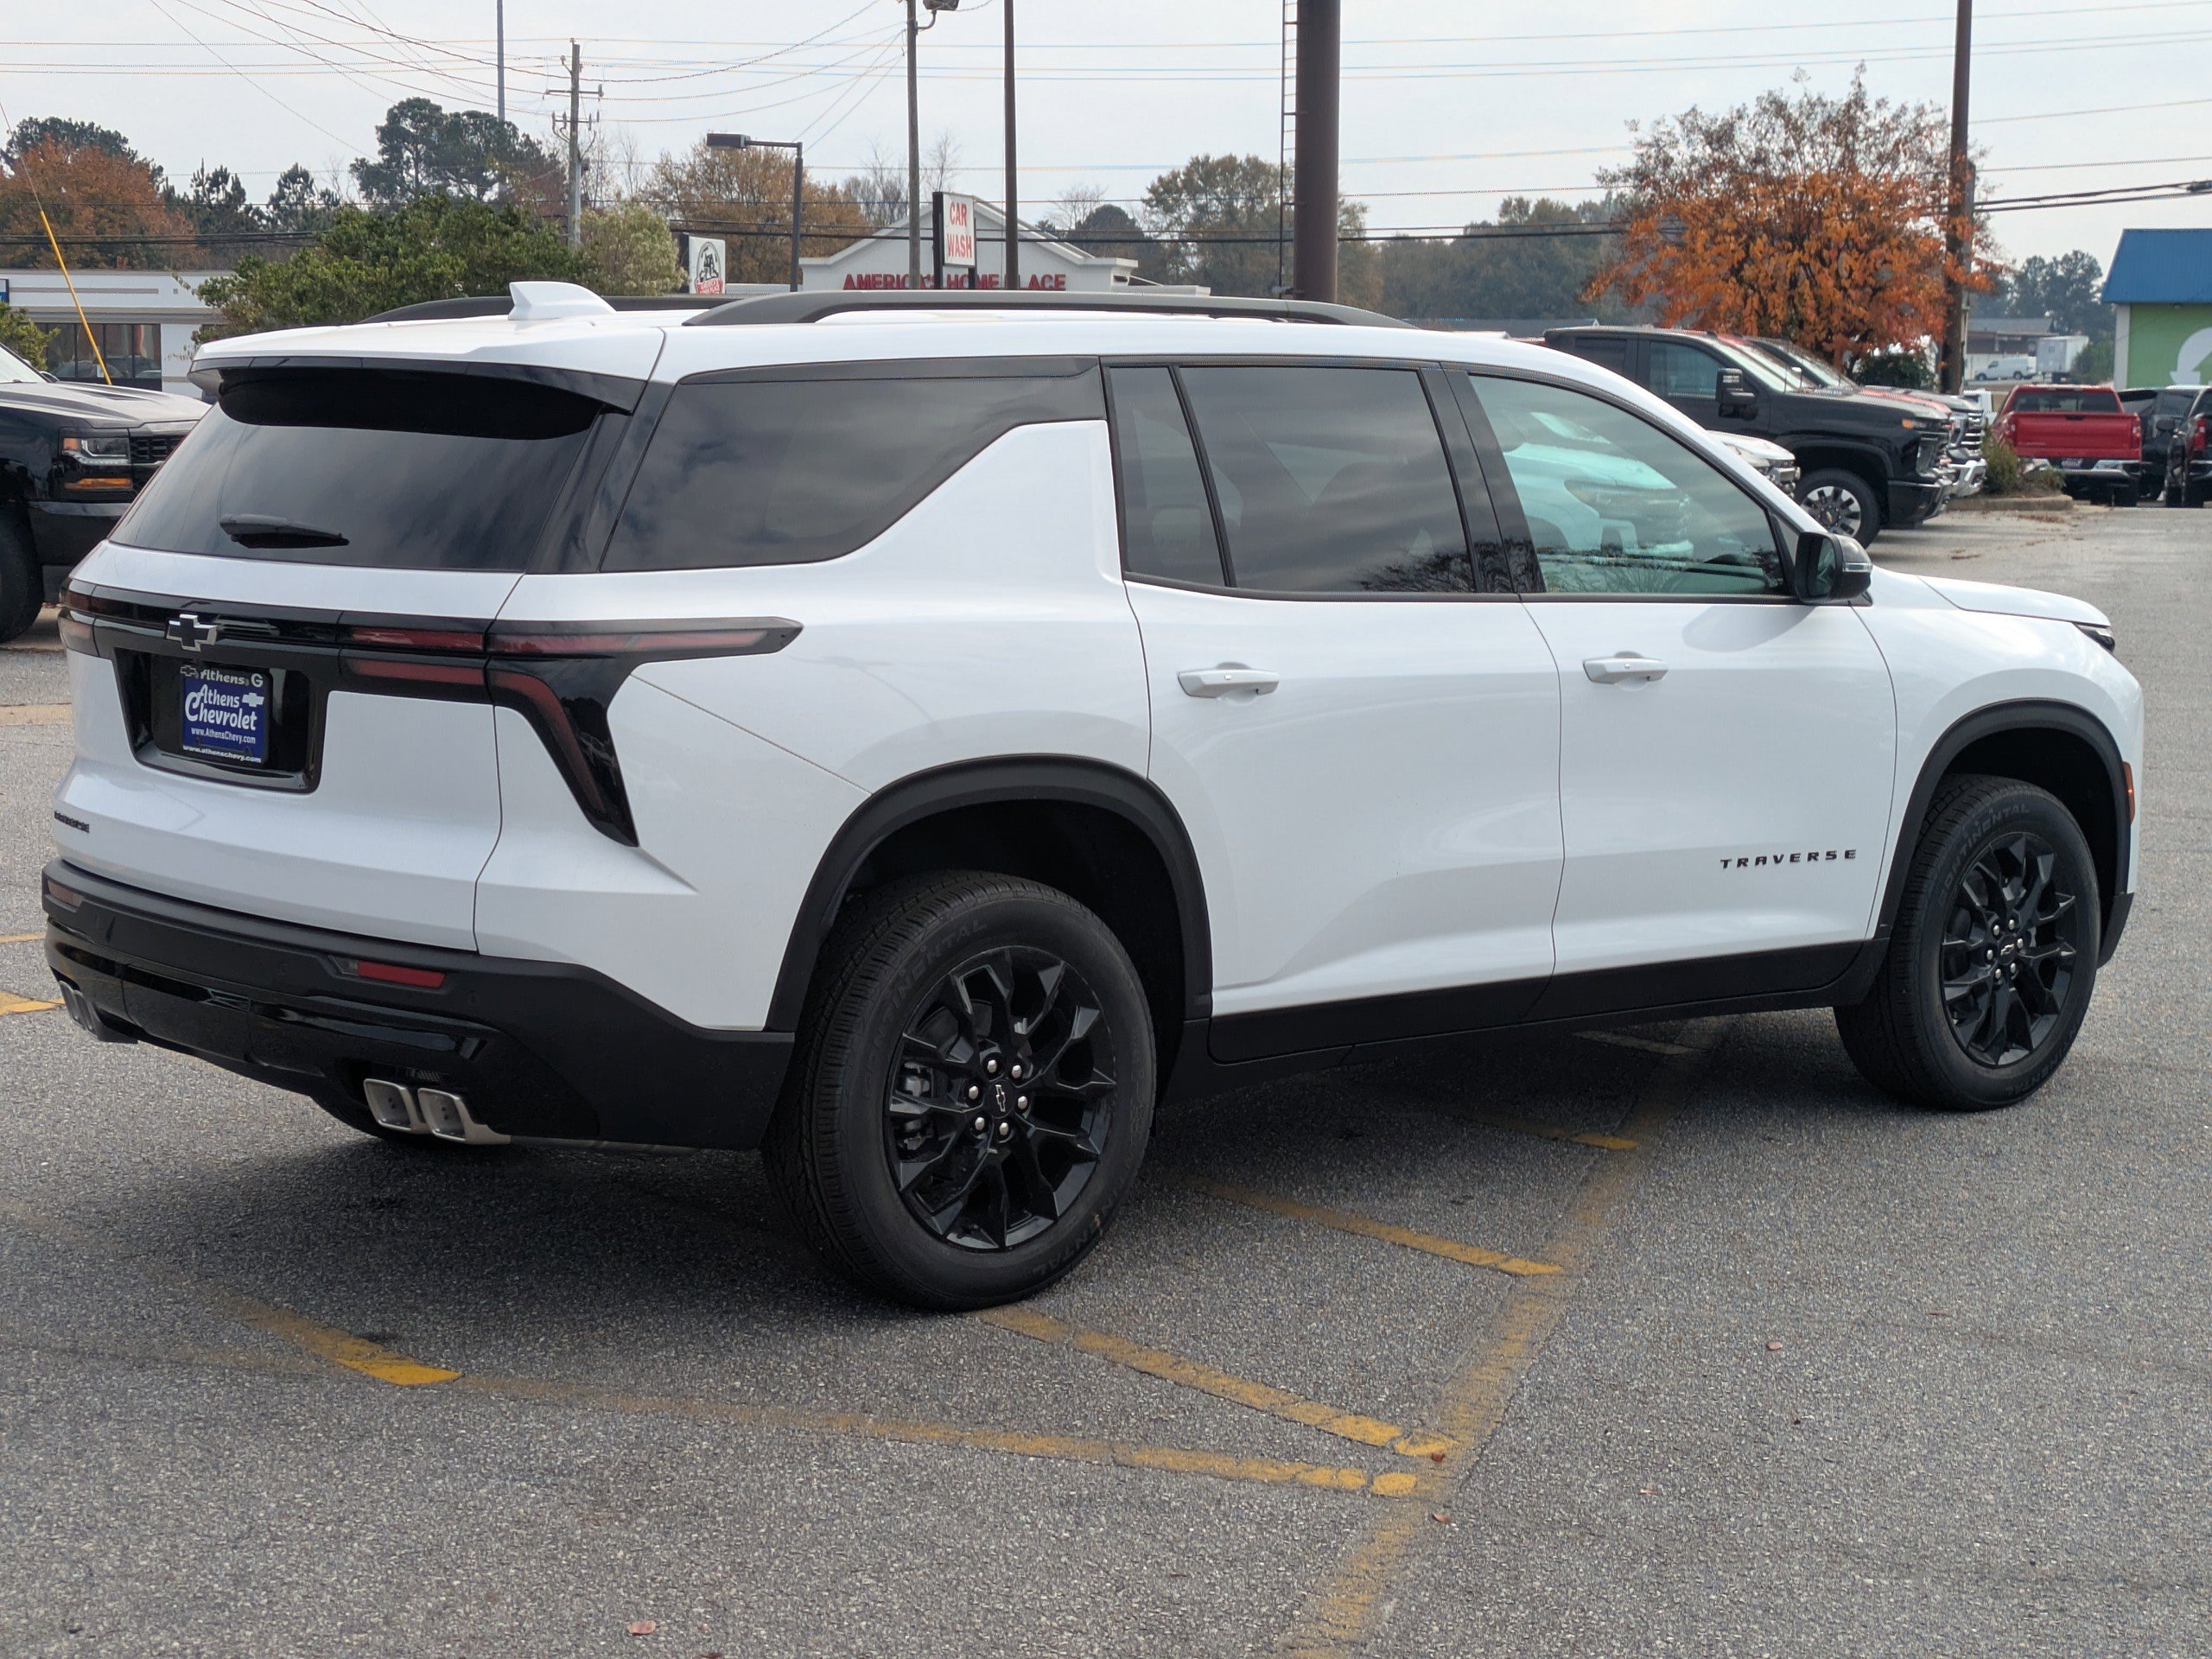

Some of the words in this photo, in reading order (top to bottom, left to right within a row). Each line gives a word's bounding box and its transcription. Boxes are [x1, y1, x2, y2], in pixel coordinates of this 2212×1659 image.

[950, 201, 967, 226] CAR
[946, 232, 972, 258] WASH
[200, 669, 245, 685] Athens
[193, 683, 240, 708] Athens
[185, 691, 257, 730] Chevrolet
[191, 727, 256, 744] www.AthensChevy.com
[1720, 849, 1856, 869] TRAVERSE
